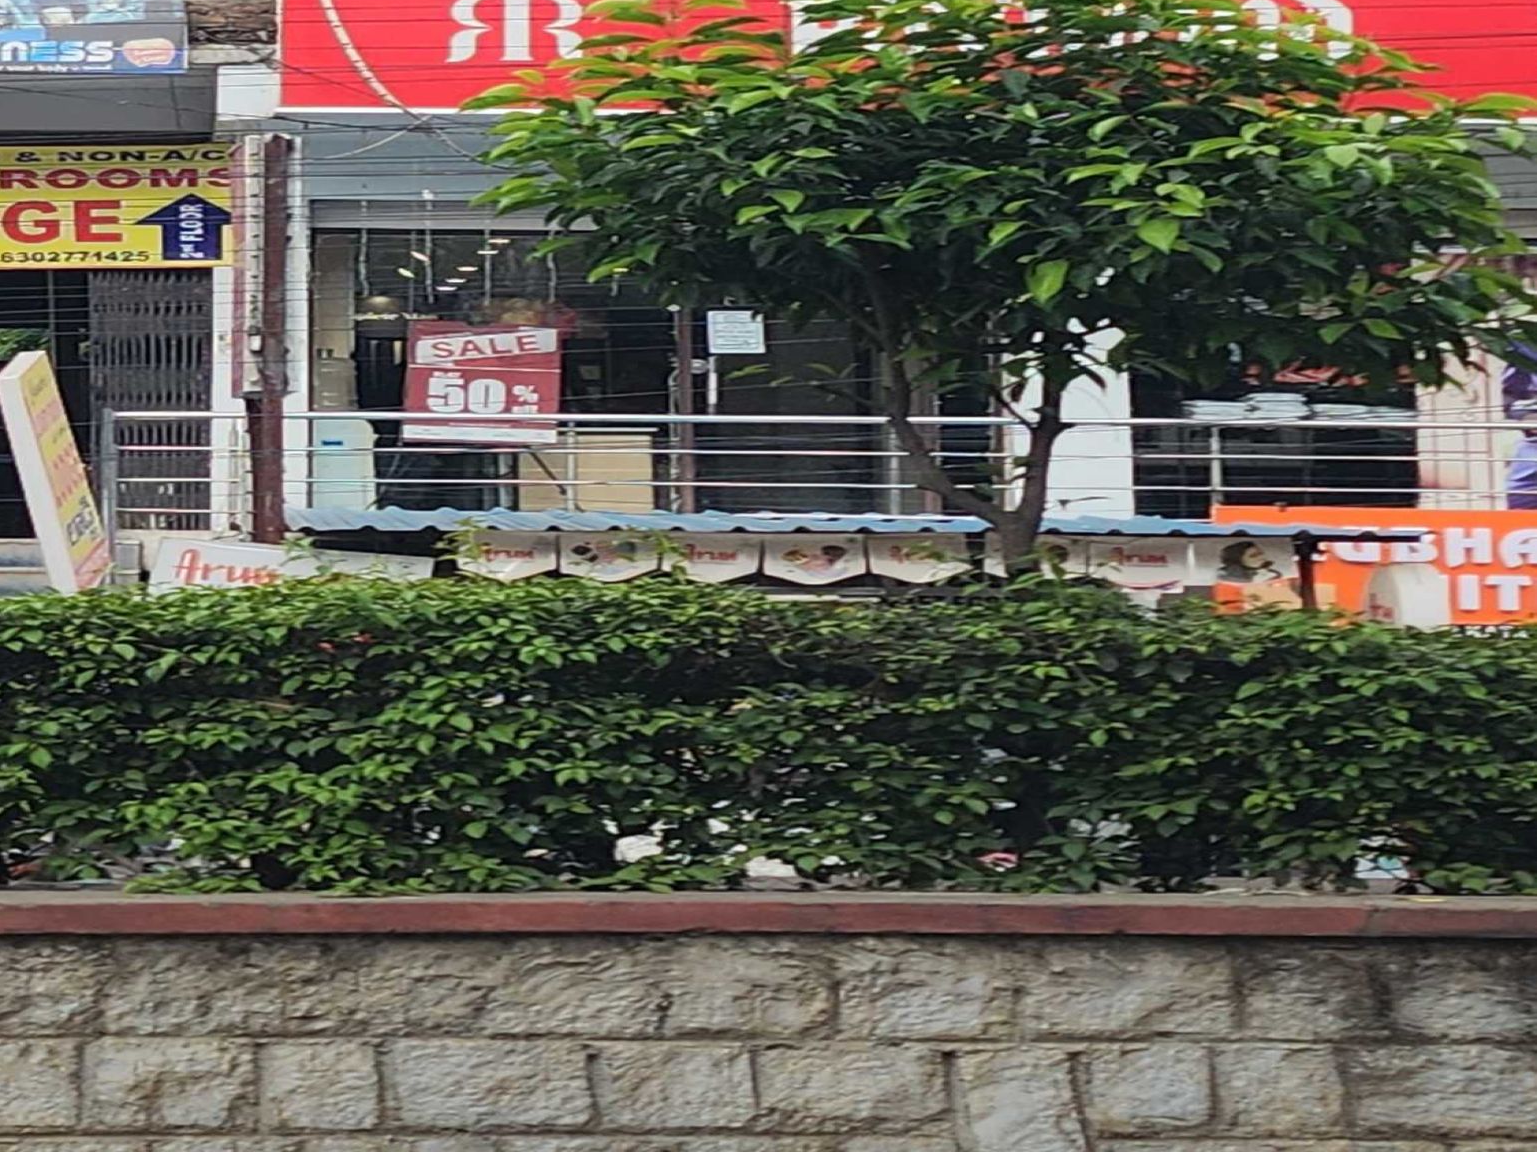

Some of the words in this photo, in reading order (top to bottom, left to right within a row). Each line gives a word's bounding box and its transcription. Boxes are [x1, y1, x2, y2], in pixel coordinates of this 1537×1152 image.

[13, 150, 44, 164] &
[56, 149, 227, 162] NON-A/C
[177, 203, 205, 242] FLOOR
[431, 334, 541, 358] SALE
